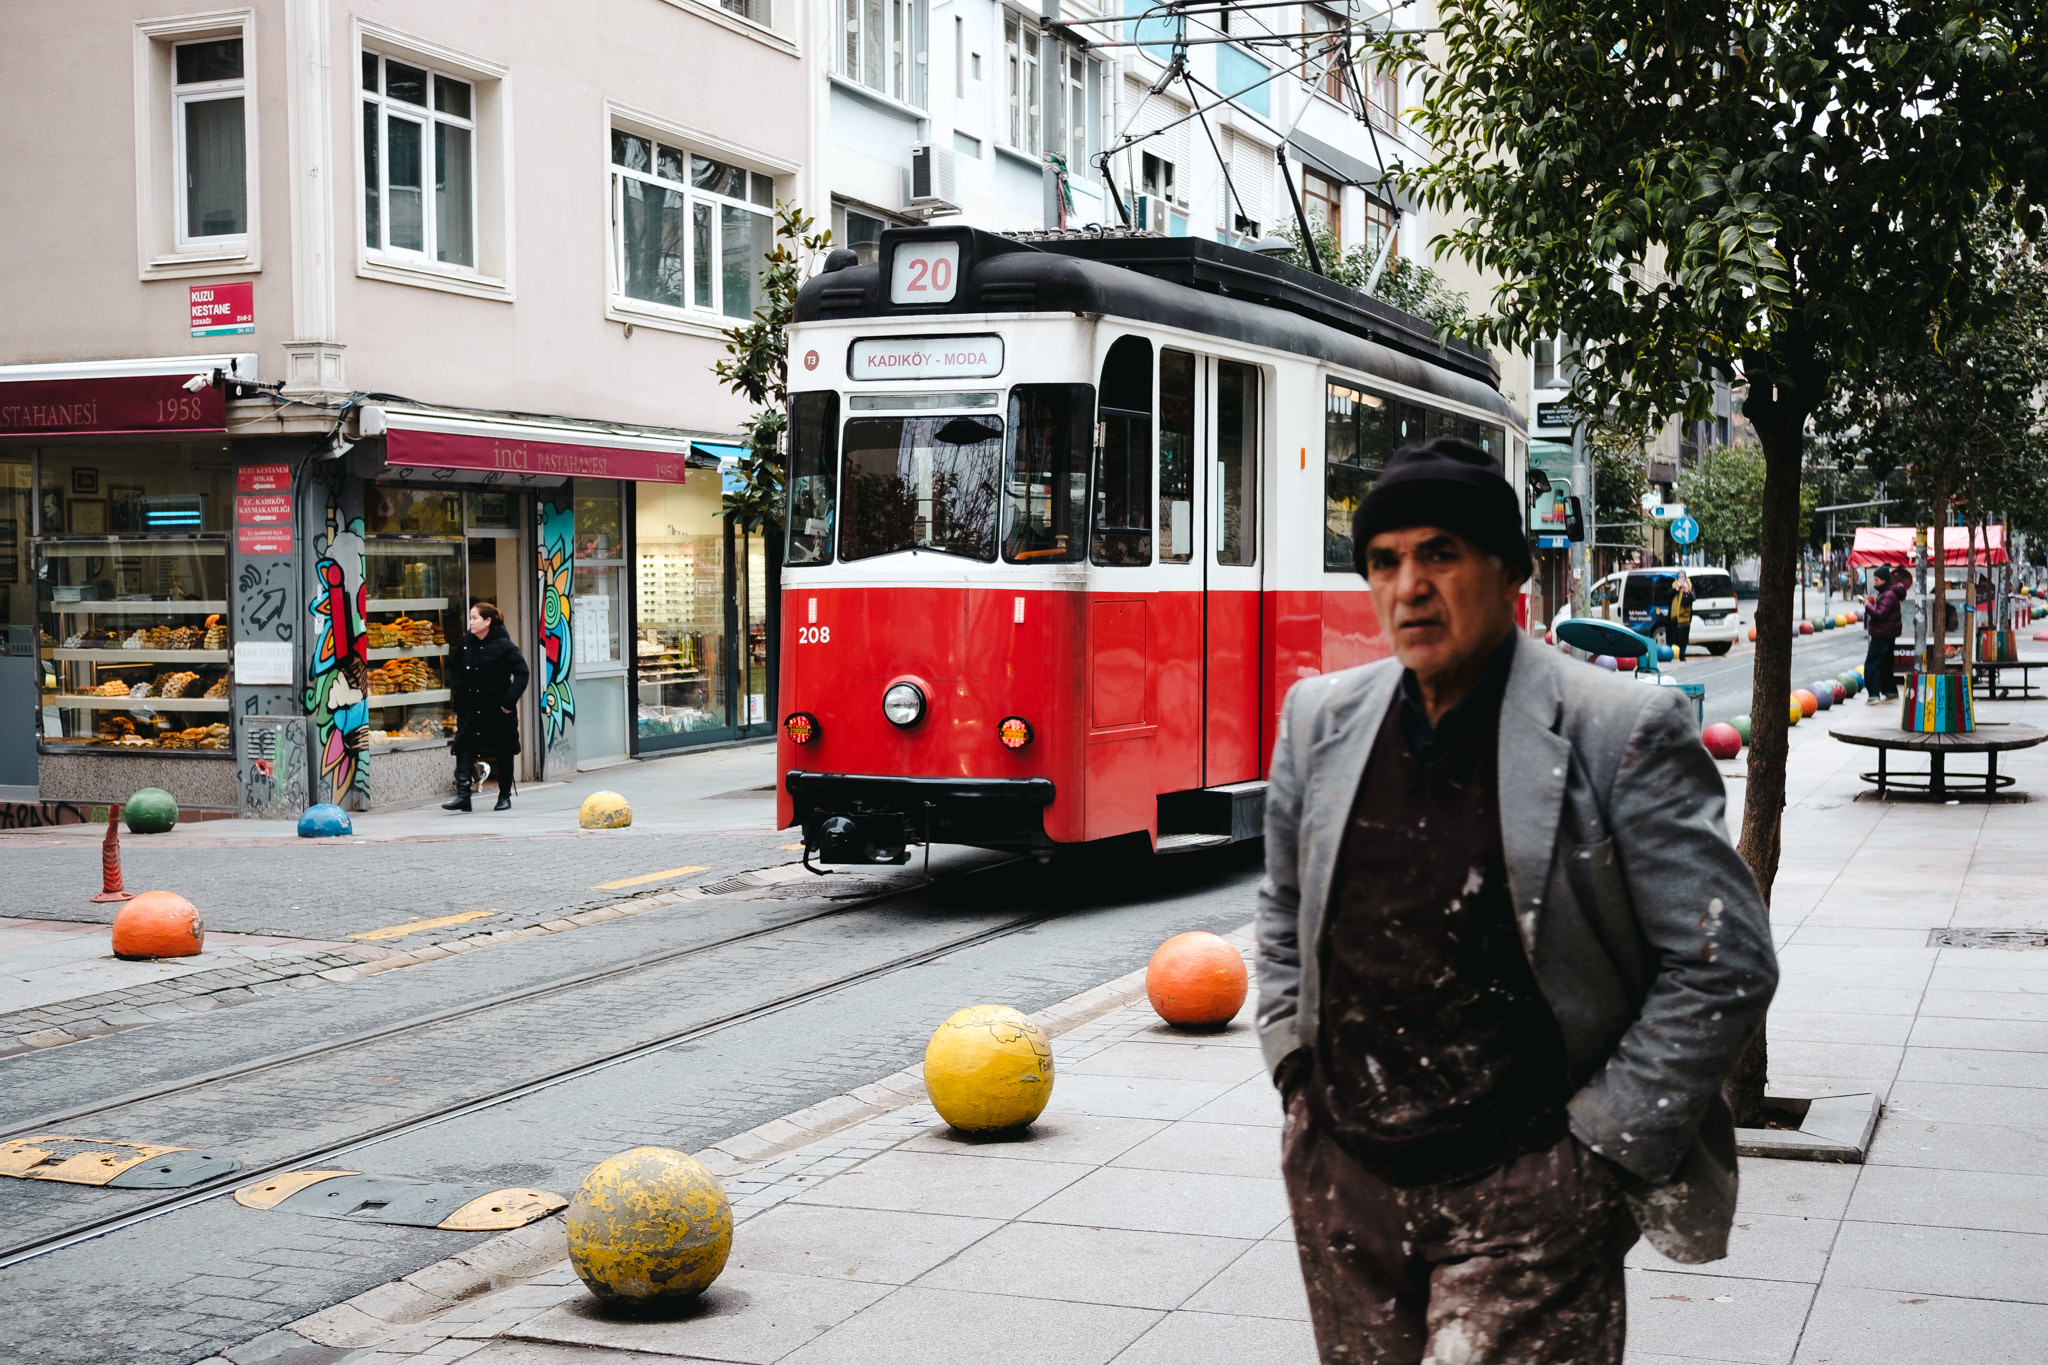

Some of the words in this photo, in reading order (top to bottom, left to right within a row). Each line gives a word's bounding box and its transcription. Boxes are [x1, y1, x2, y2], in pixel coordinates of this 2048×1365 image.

[906, 257, 952, 292] 20
[191, 290, 214, 302] KUZU
[192, 303, 231, 316] KESTANE
[806, 356, 817, 365] T3
[867, 351, 932, 368] KADIKÖY
[944, 352, 987, 366] MODA
[0, 399, 98, 427] STAHANESİ
[157, 397, 201, 422] 1958
[494, 441, 529, 470] inci
[537, 454, 608, 475] PASTAHANESİ
[655, 463, 679, 479] 1958
[255, 497, 286, 505] KADIKÖY
[239, 504, 290, 514] KAYMAKAMLIĞI
[799, 626, 830, 644] 208
